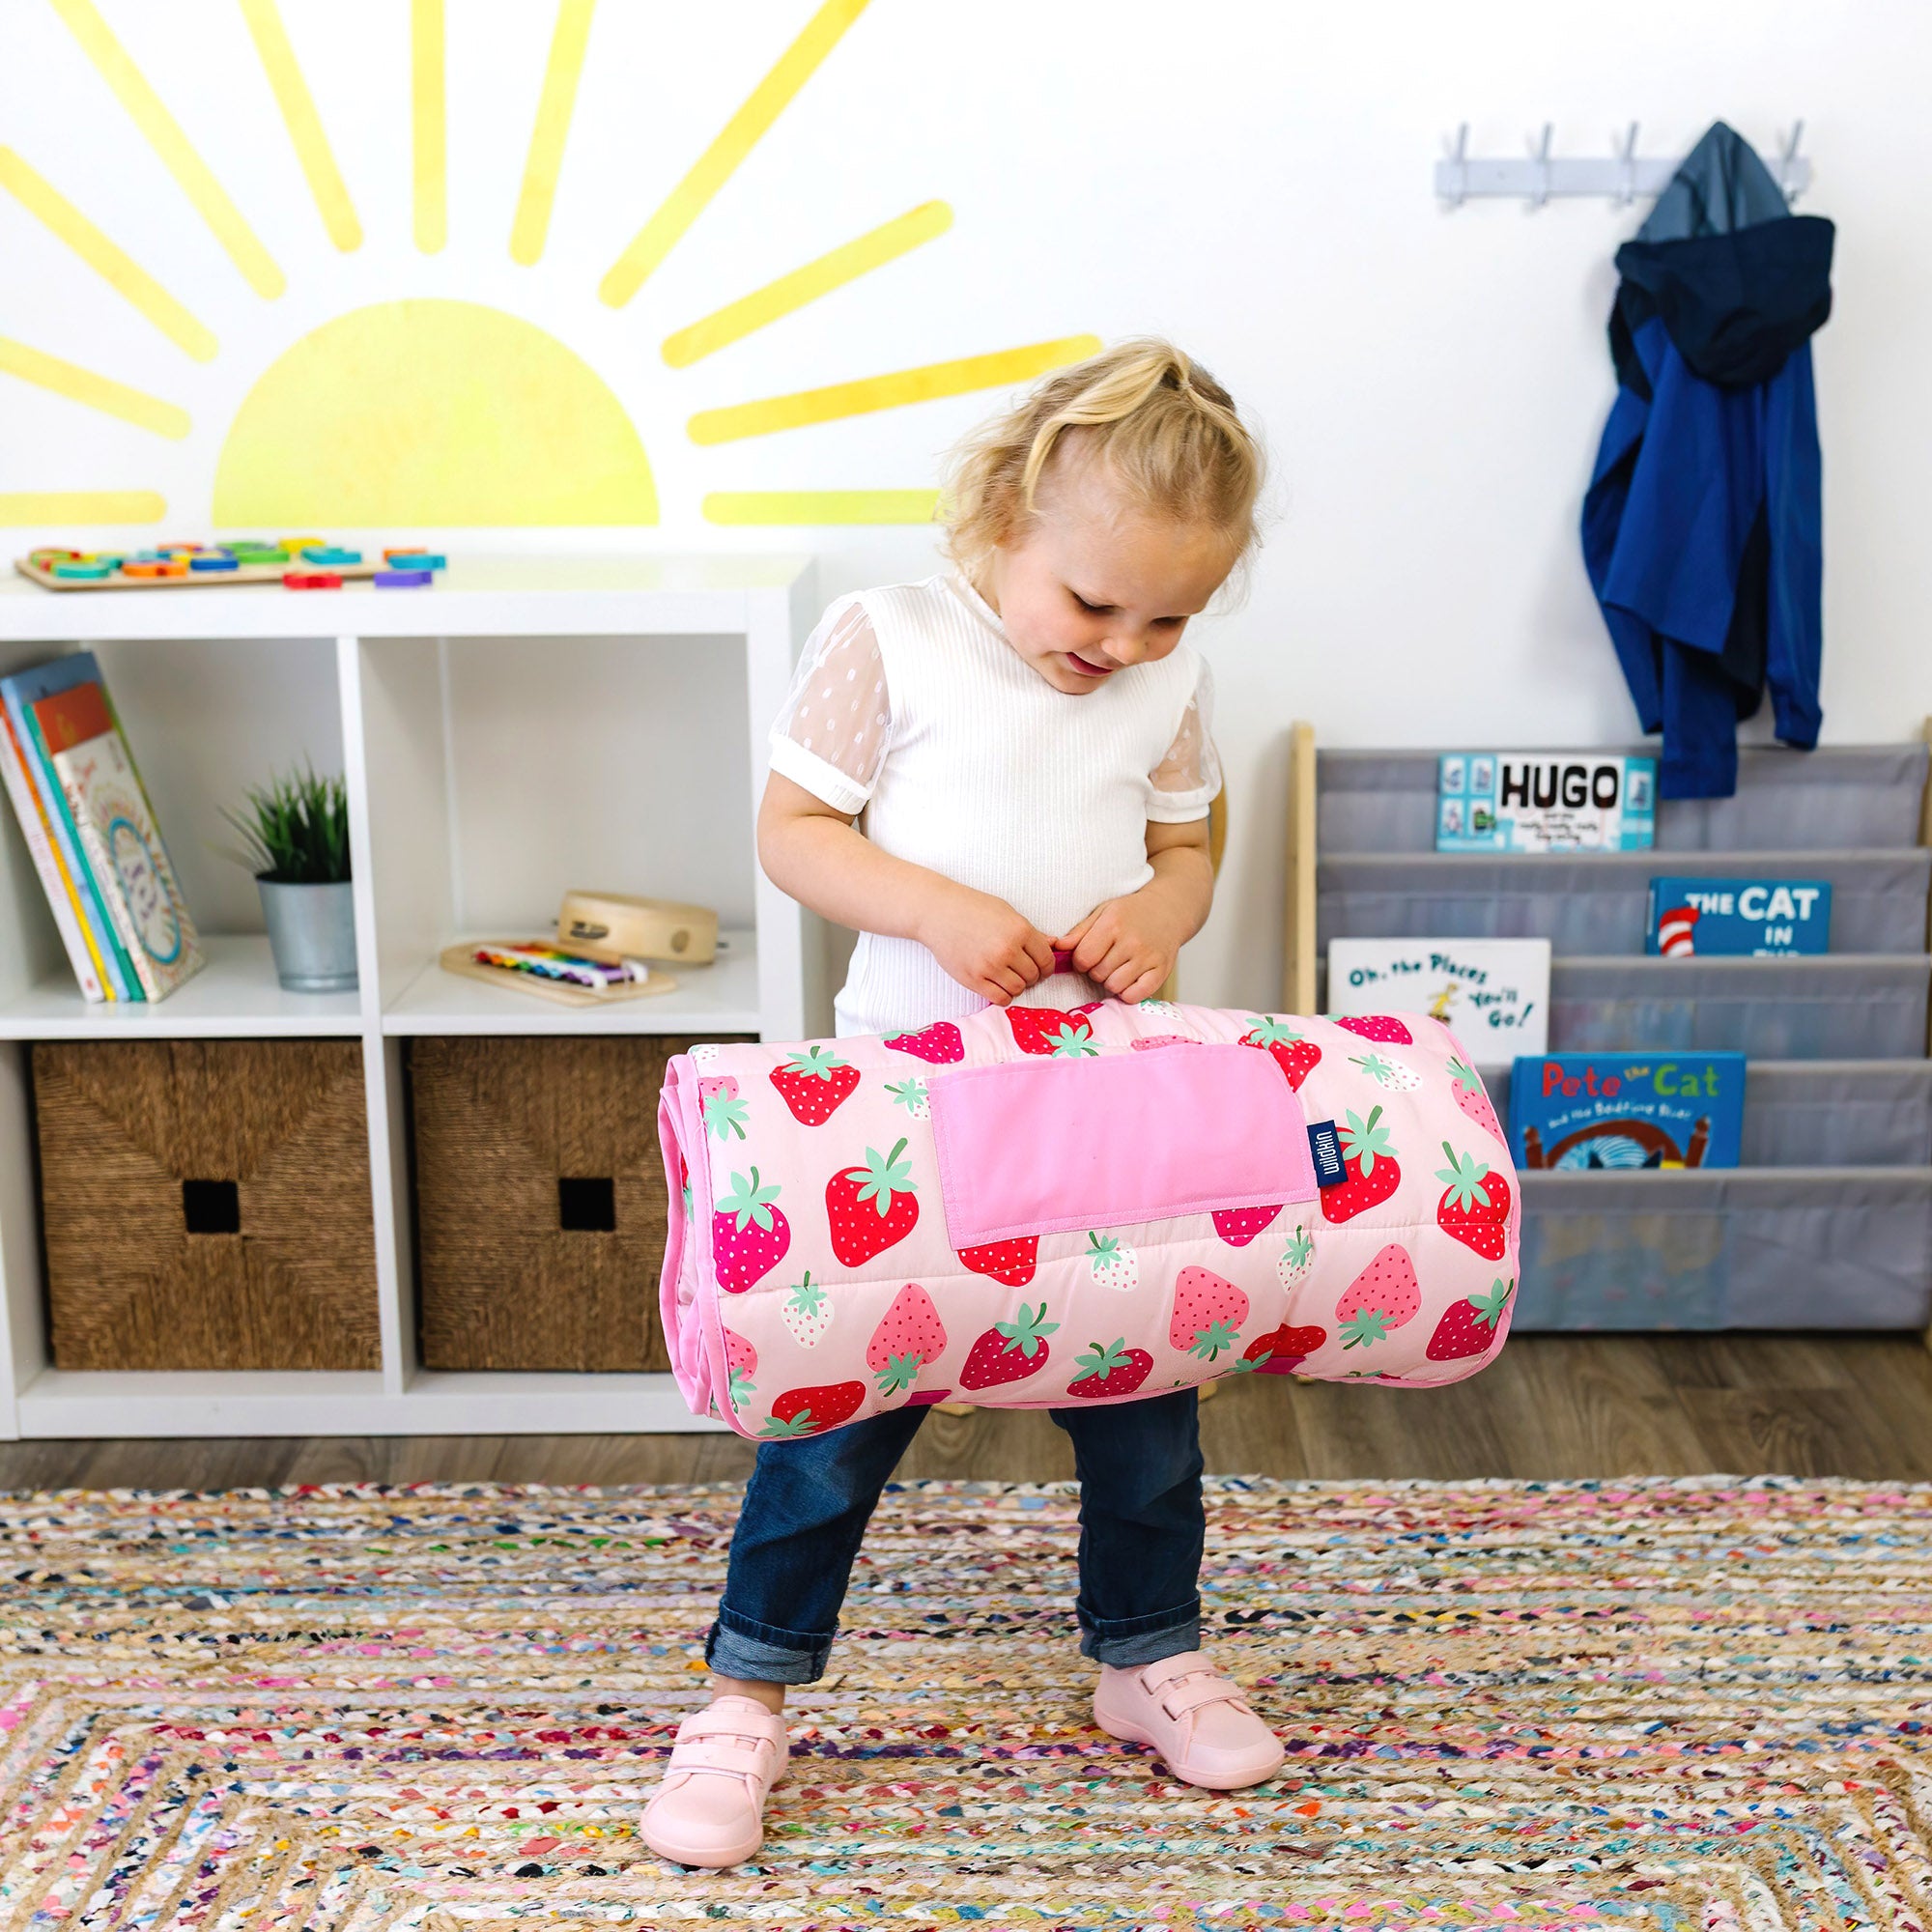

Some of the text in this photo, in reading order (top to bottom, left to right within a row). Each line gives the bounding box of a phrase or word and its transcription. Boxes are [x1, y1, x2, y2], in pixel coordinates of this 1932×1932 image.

[1500, 764, 1619, 809] HUGO
[1685, 886, 1820, 921] THE CAT
[1765, 925, 1793, 946] IN
[1391, 960, 1421, 973] the
[1429, 952, 1488, 985] Places
[1468, 986, 1518, 1009] You'll
[1489, 1002, 1534, 1028] Go!
[1542, 1062, 1621, 1097] Pete
[1654, 1064, 1719, 1096] Cat
[1315, 1130, 1340, 1176] wildkin
